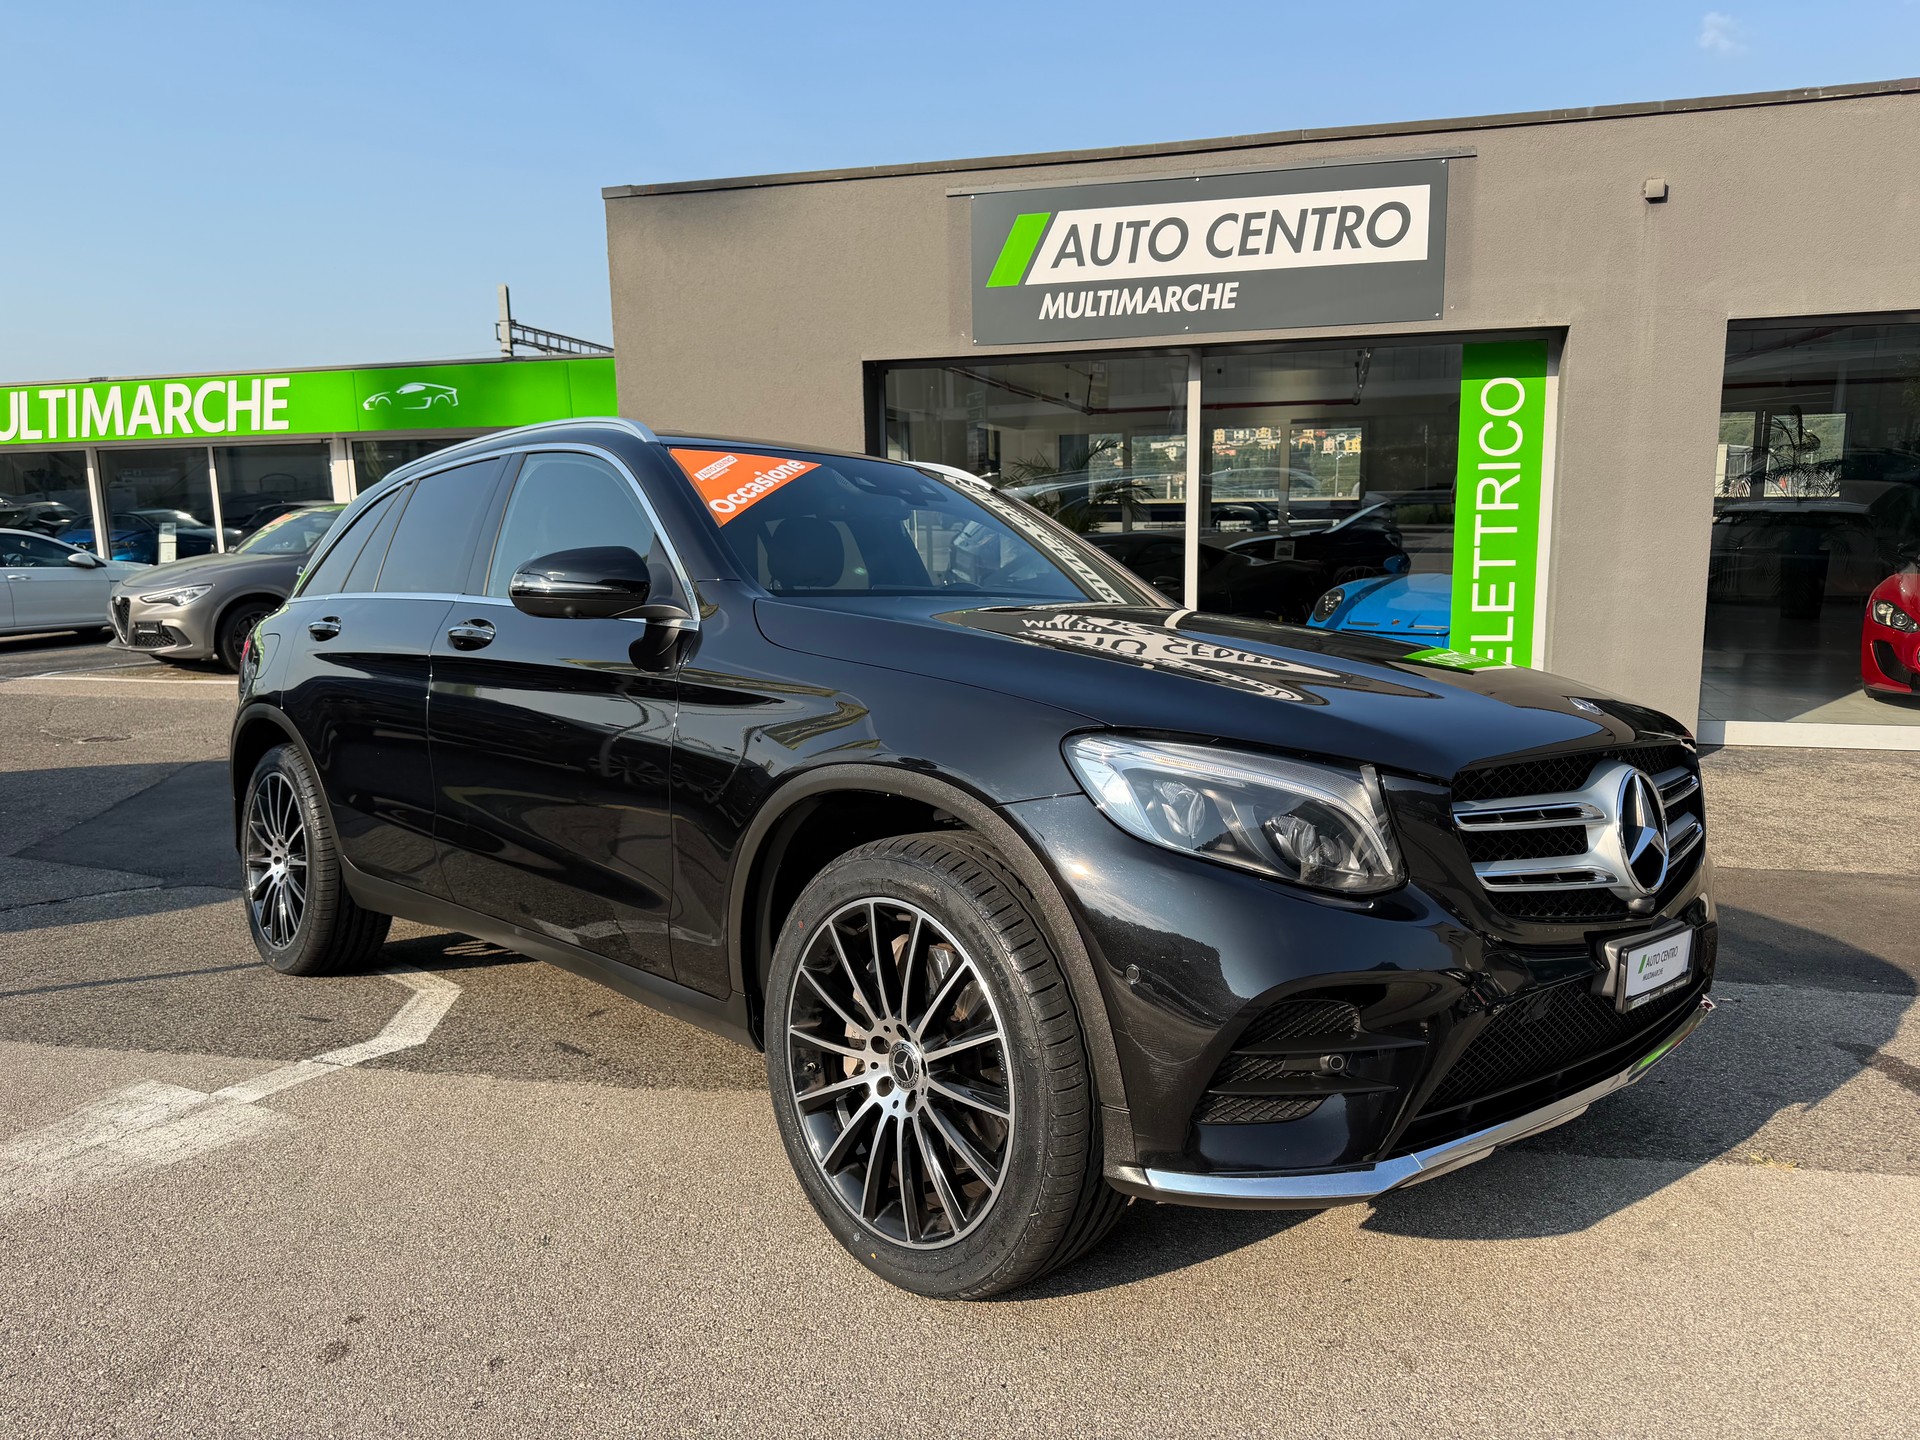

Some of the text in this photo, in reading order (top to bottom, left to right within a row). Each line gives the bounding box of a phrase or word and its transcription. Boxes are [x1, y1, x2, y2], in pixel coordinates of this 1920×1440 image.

[1050, 200, 1412, 268] AUTO CENTRO
[1038, 281, 1239, 320] MULTIMARCHE
[708, 459, 806, 513] Occasione
[1645, 946, 1678, 968] AUTO CENTRO
